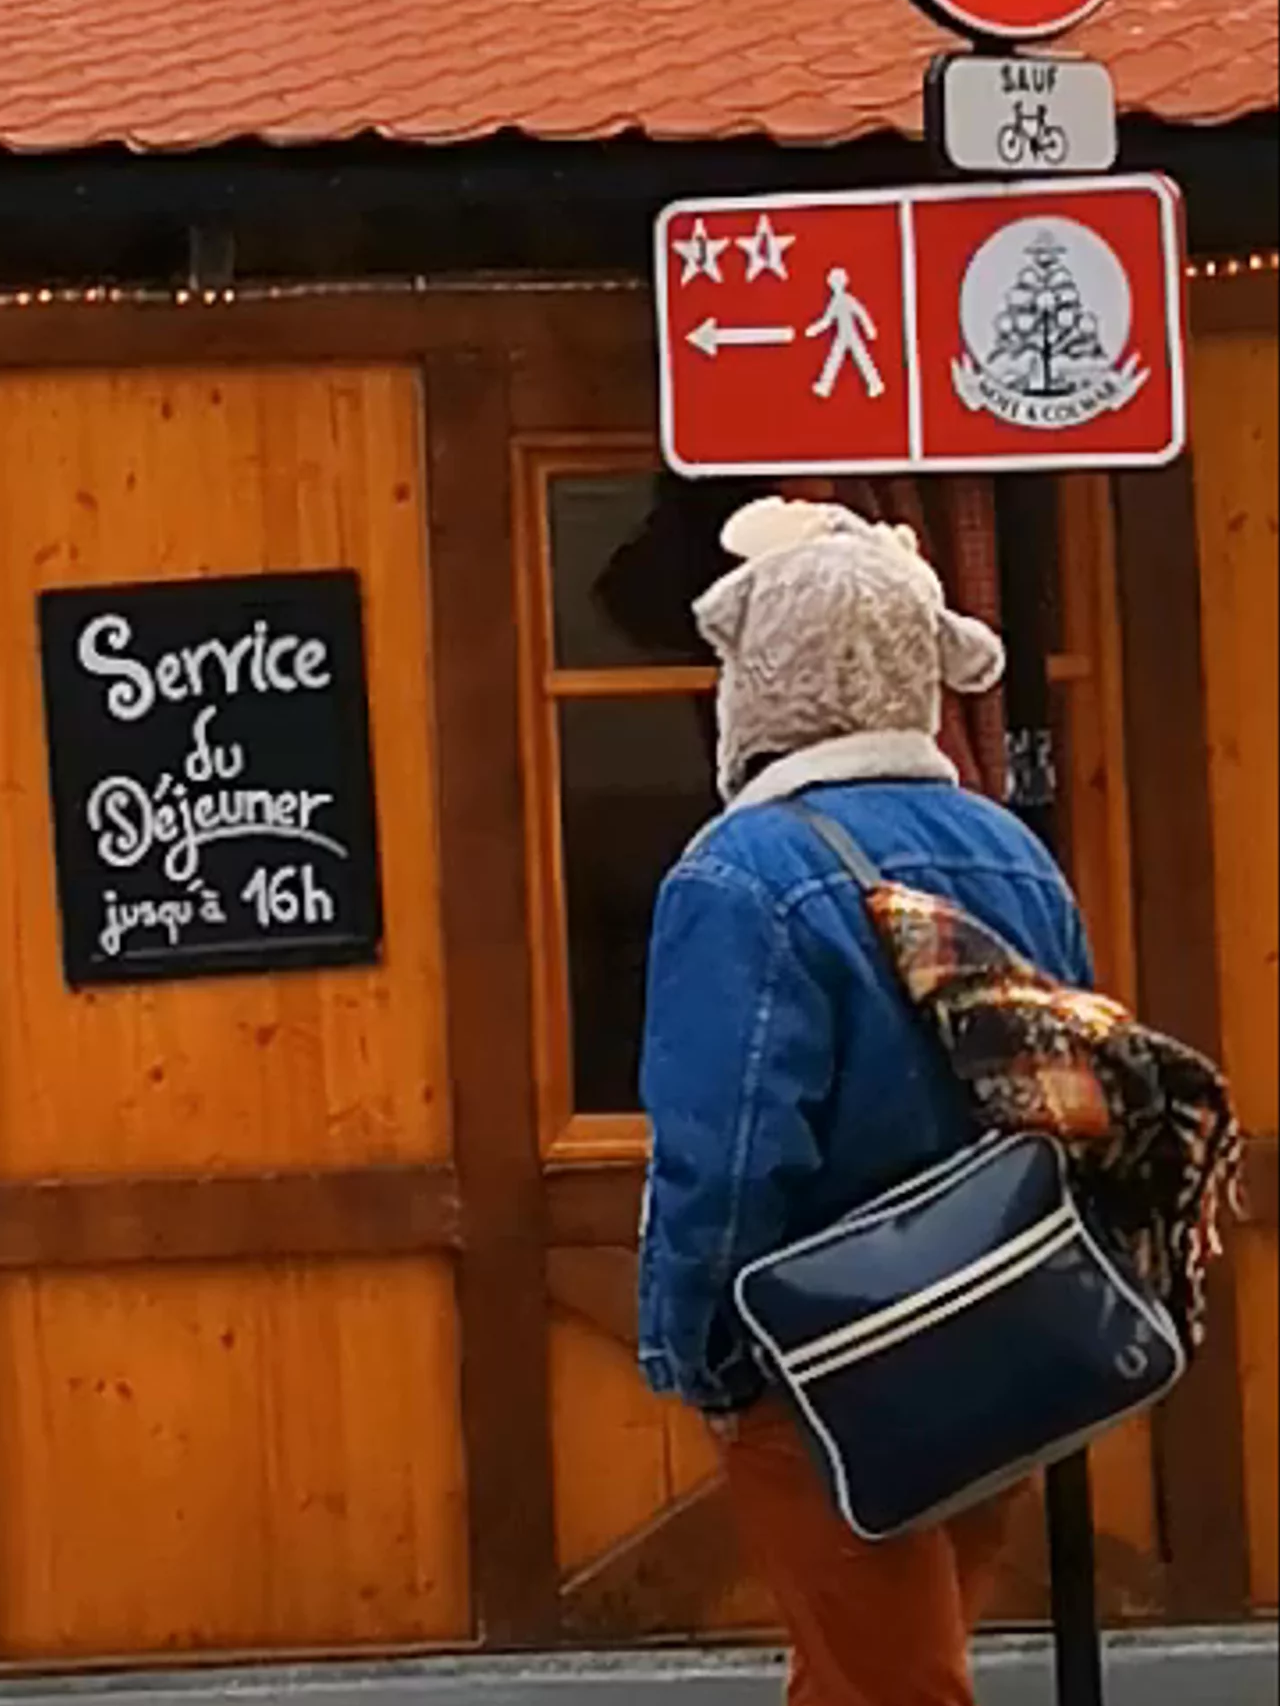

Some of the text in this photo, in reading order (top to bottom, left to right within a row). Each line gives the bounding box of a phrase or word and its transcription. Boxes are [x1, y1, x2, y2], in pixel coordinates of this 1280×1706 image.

[1000, 64, 1058, 94] SAUF
[77, 613, 333, 722] Service
[185, 705, 244, 782] du
[86, 772, 348, 881] Déjeuner
[99, 864, 334, 955] jusqu'à 16h
